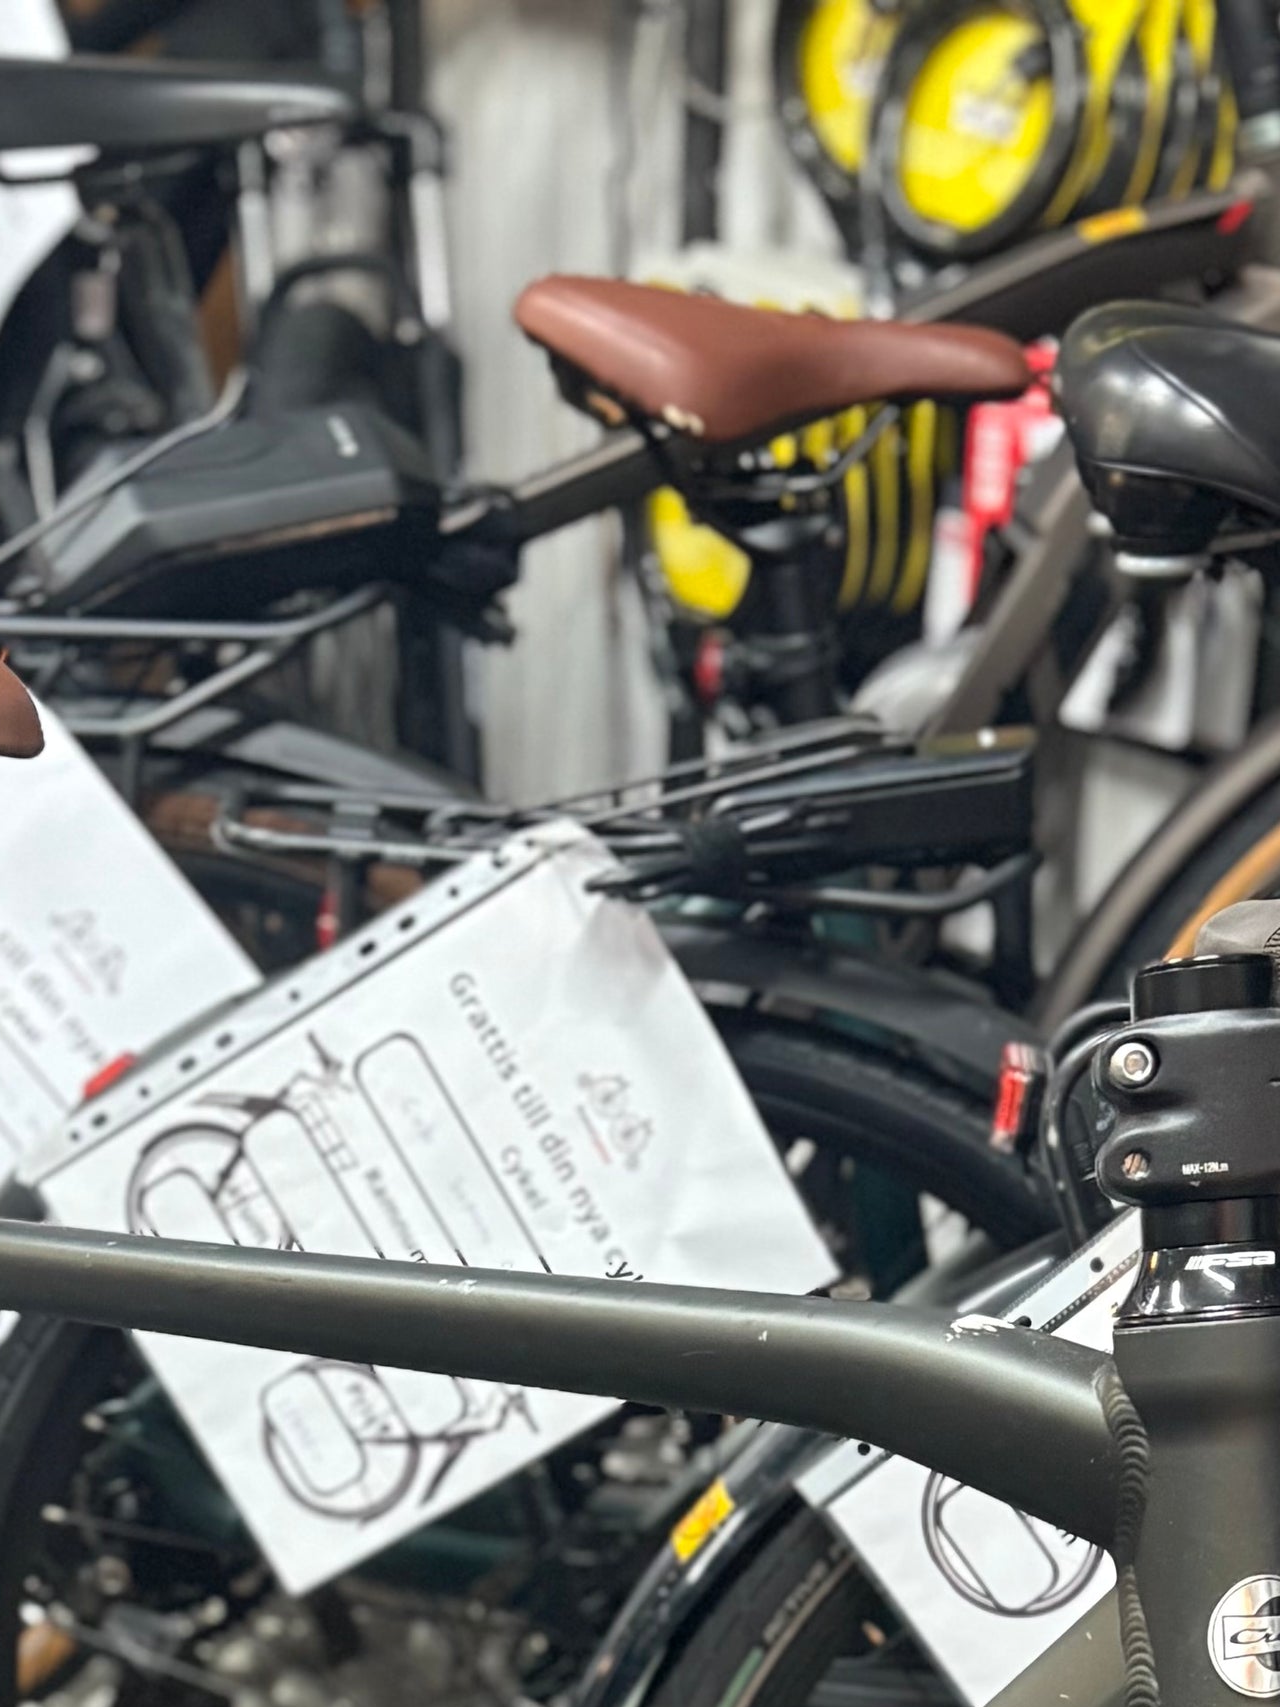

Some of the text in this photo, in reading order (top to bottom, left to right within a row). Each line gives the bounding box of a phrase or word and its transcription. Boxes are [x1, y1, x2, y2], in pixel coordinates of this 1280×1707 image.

[448, 970, 520, 1082] Grattis
[511, 1082, 553, 1130] till
[538, 1132, 576, 1185] din
[568, 1185, 613, 1245] nya
[499, 1144, 547, 1211] Cykel
